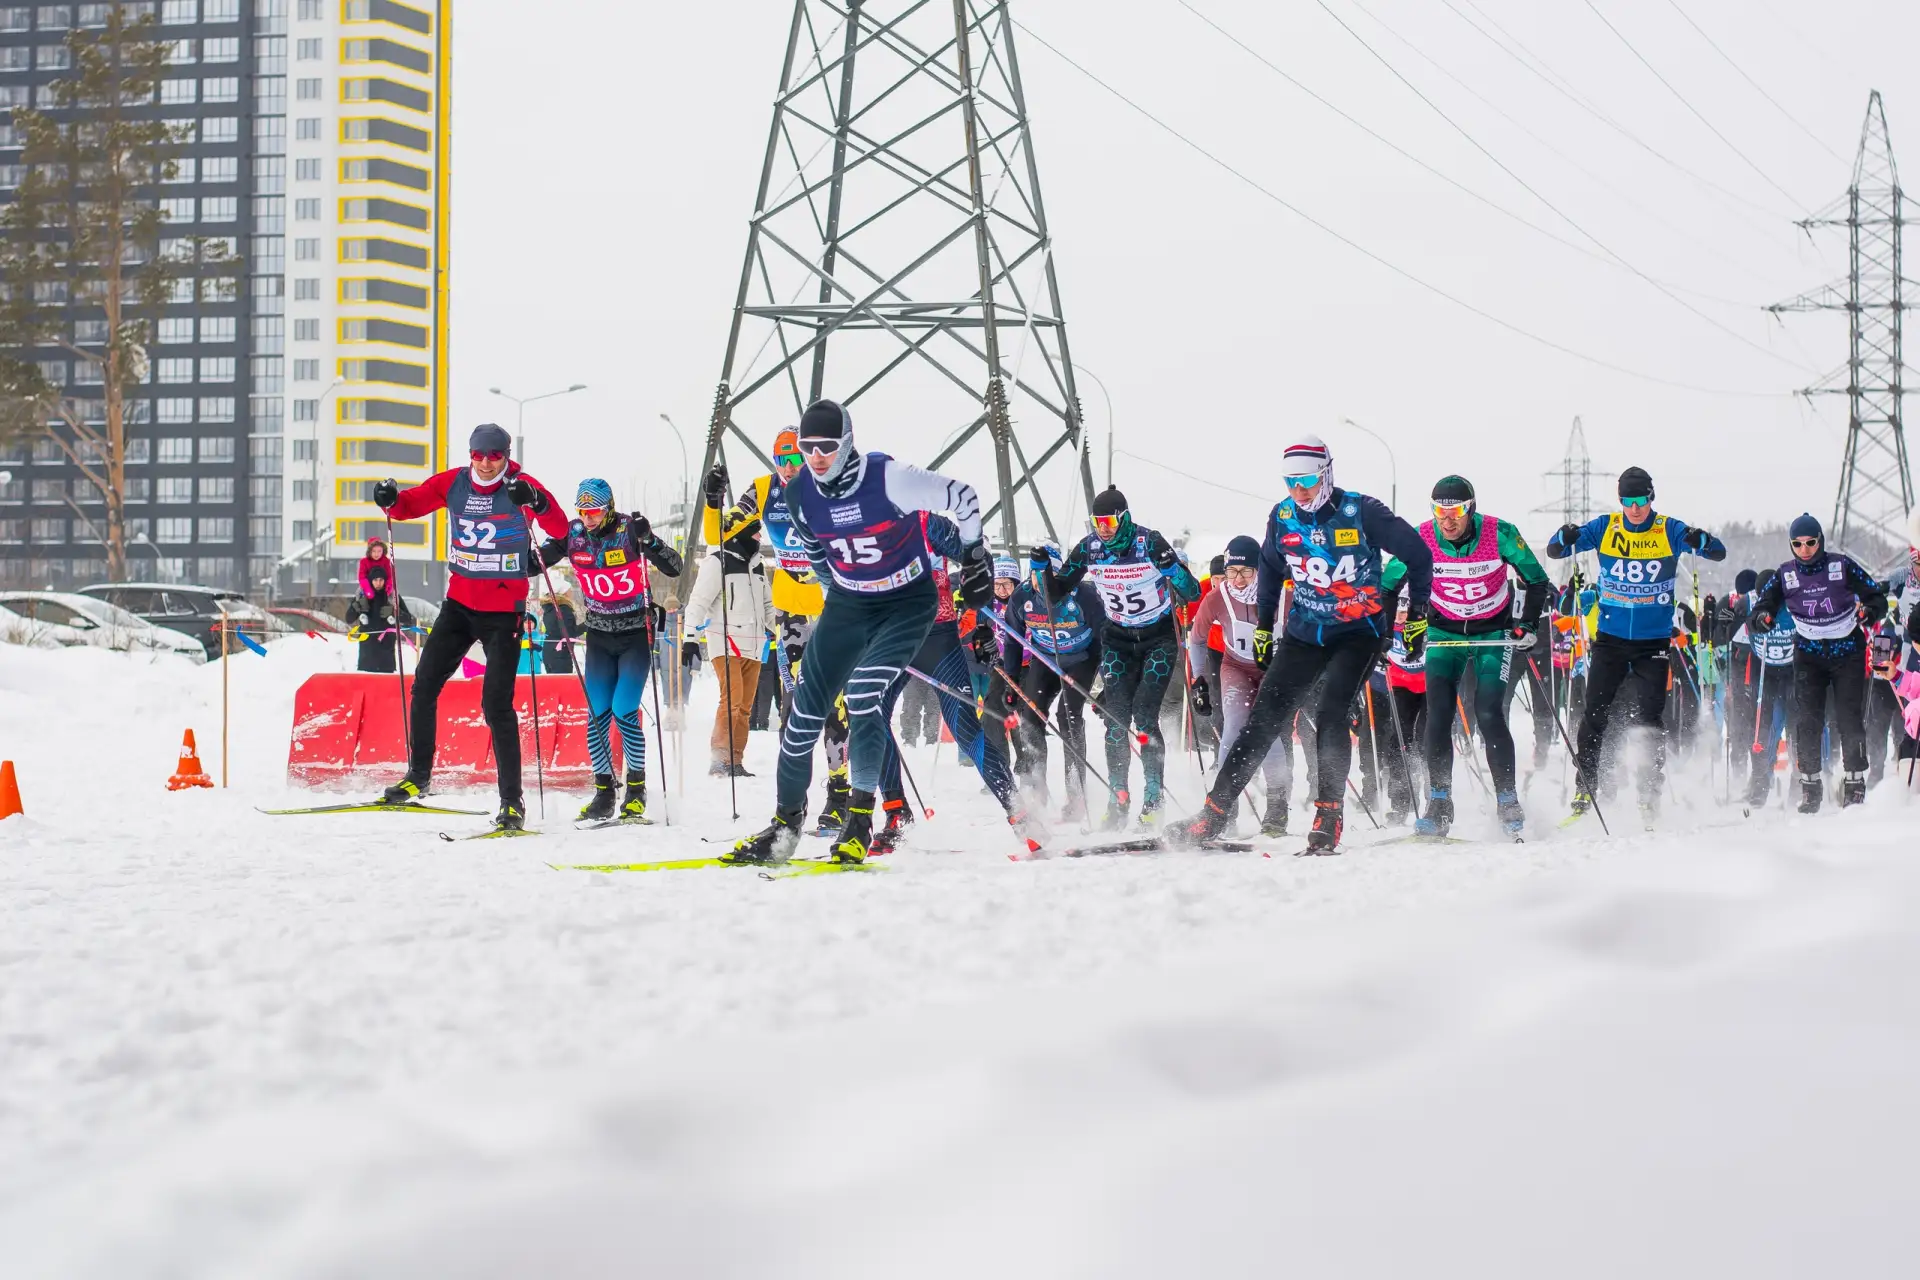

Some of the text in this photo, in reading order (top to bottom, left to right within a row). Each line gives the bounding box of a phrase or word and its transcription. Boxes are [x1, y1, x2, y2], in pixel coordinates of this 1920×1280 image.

[768, 512, 791, 520] ЕВРО
[459, 519, 497, 549] 32
[784, 527, 804, 546] 6
[829, 537, 883, 565] 15
[1632, 541, 1659, 549] NIKA
[1103, 565, 1151, 574] АВАЧИНСКИЙ
[1610, 559, 1661, 583] 489
[582, 569, 635, 597] 103
[1440, 581, 1488, 600] 26
[1105, 591, 1146, 615] 35
[1802, 597, 1834, 616] 71
[1754, 636, 1792, 644] ПРКТИКА
